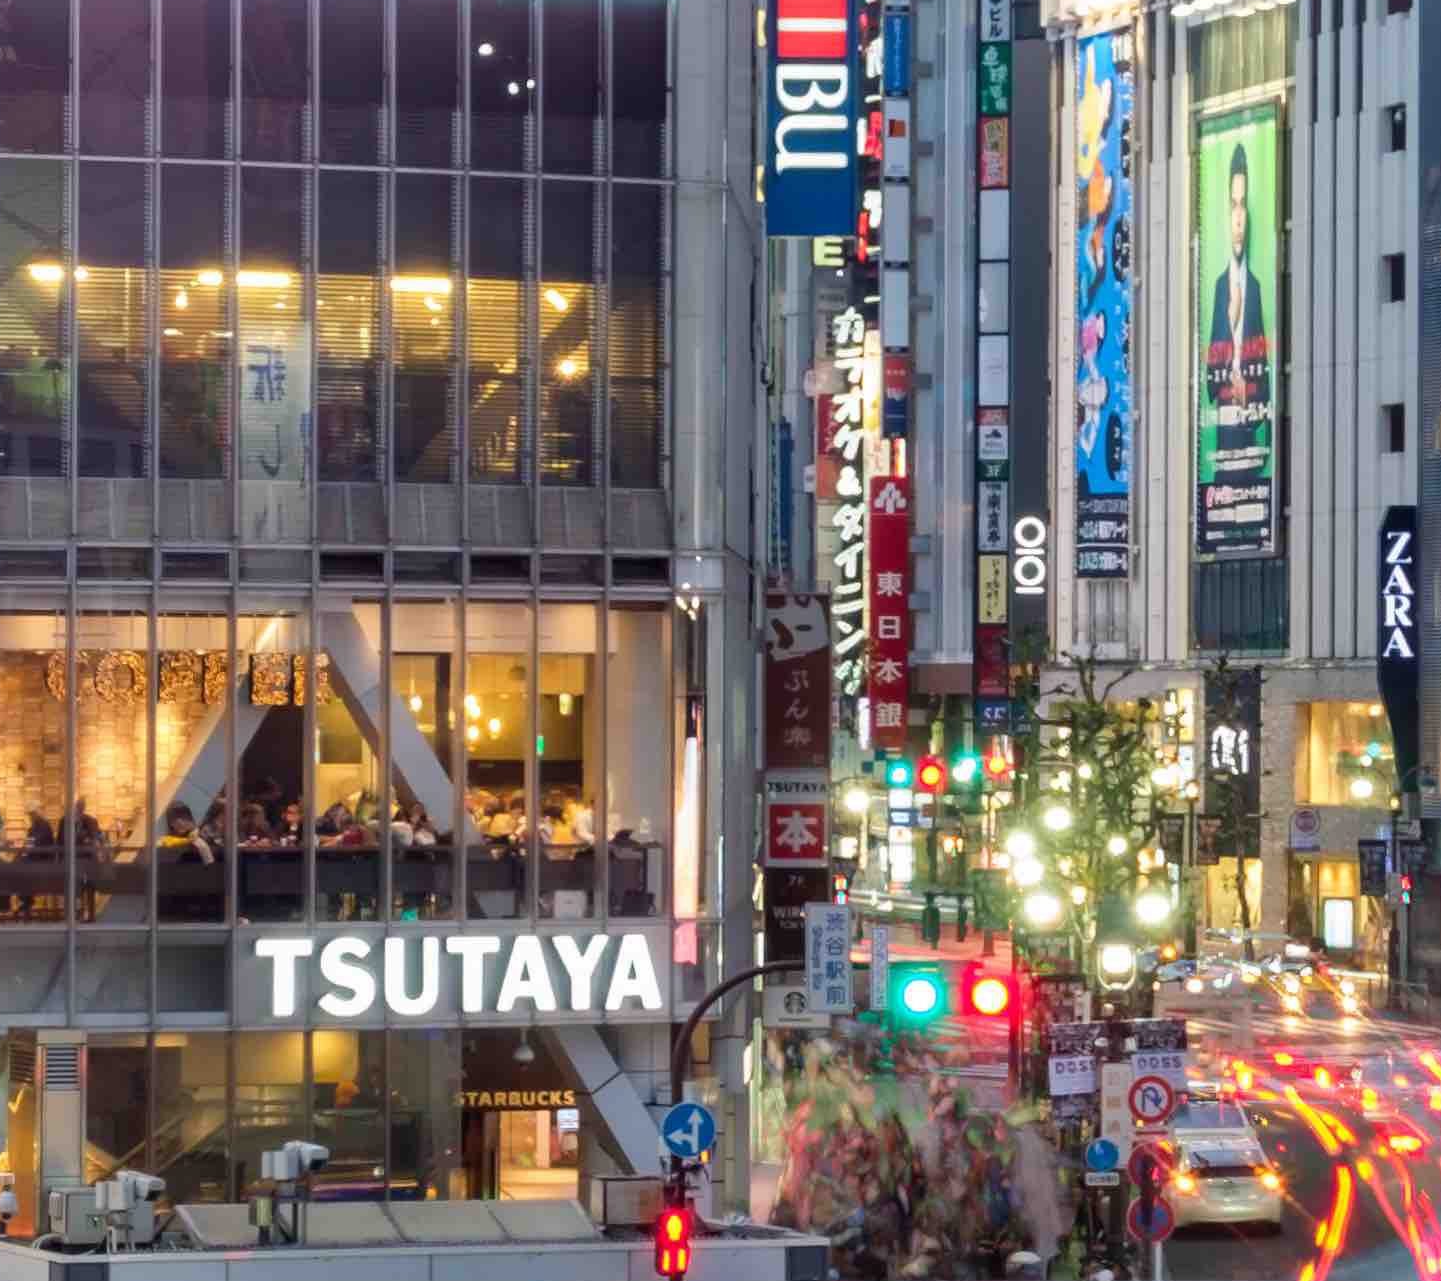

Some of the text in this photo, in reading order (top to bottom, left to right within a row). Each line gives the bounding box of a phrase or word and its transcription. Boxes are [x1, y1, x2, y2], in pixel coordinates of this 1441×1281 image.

[1382, 531, 1414, 659] ZARA
[767, 781, 828, 794] TSUTAYA
[775, 810, 818, 854] 本
[255, 933, 663, 1018] TSUTAYA
[456, 1089, 576, 1107] STARBUCKS
